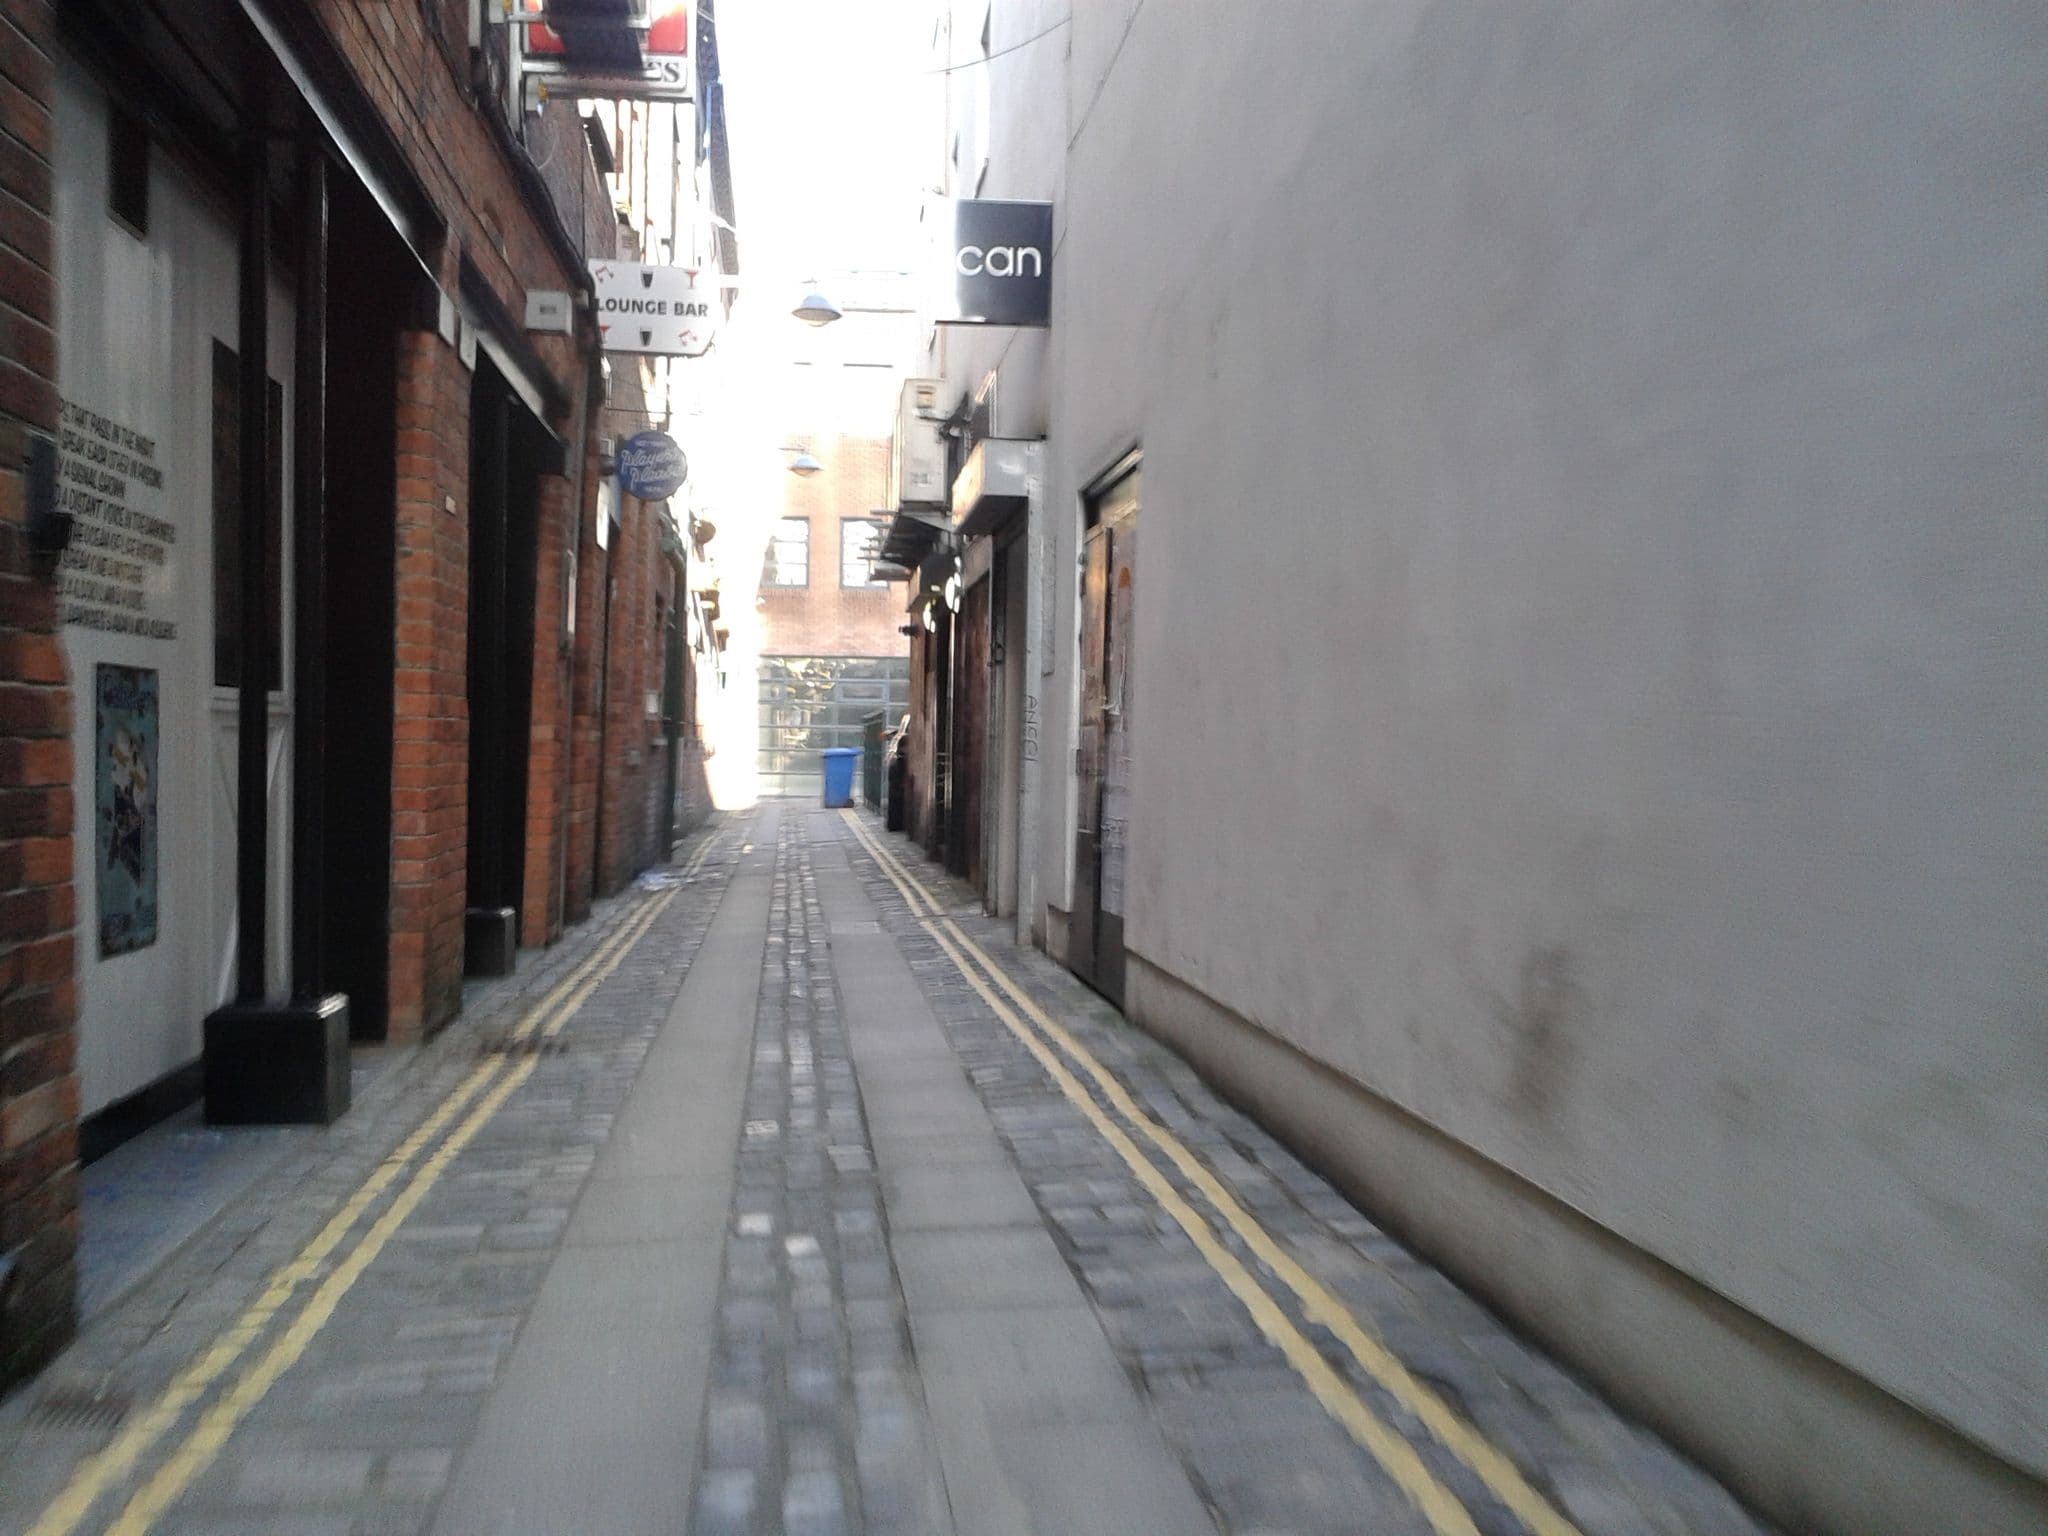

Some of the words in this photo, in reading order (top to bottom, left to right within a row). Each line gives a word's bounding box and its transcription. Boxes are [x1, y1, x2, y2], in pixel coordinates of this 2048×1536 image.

[955, 245, 1041, 277] can
[594, 298, 668, 315] LOUNGE
[674, 302, 709, 317] BAR
